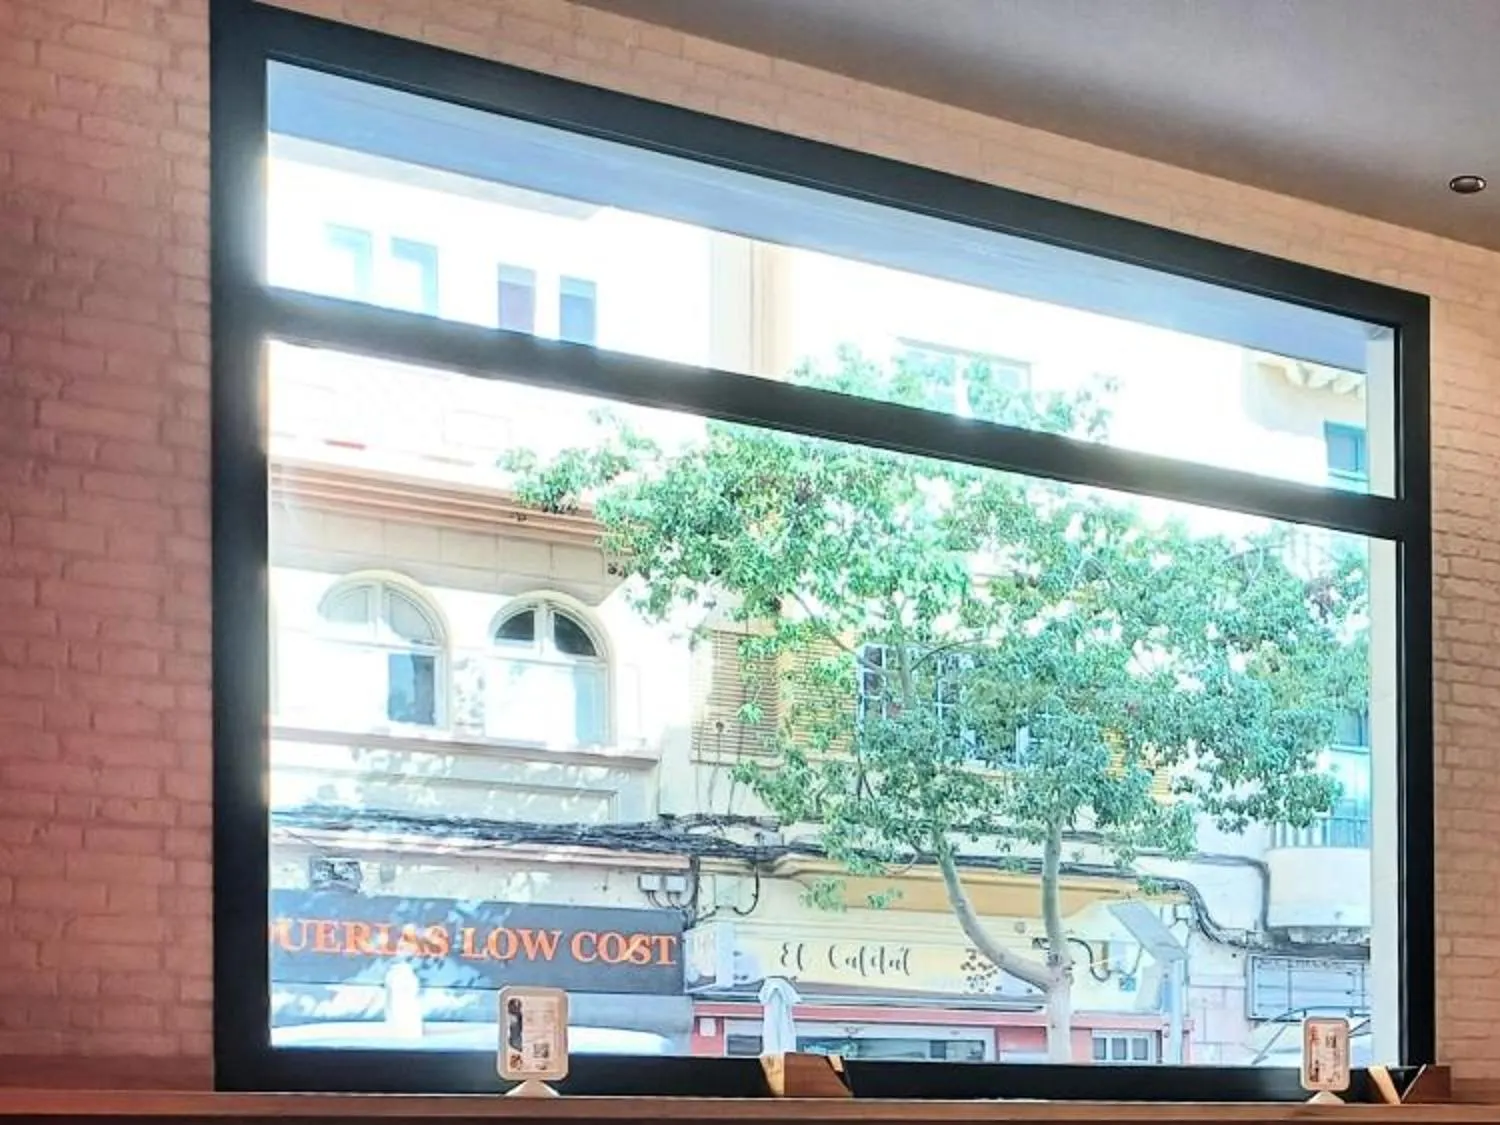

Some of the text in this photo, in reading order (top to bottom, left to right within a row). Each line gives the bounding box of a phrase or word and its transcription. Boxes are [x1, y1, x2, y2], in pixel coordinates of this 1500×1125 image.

[270, 917, 678, 967] UERIAS LOW COST
